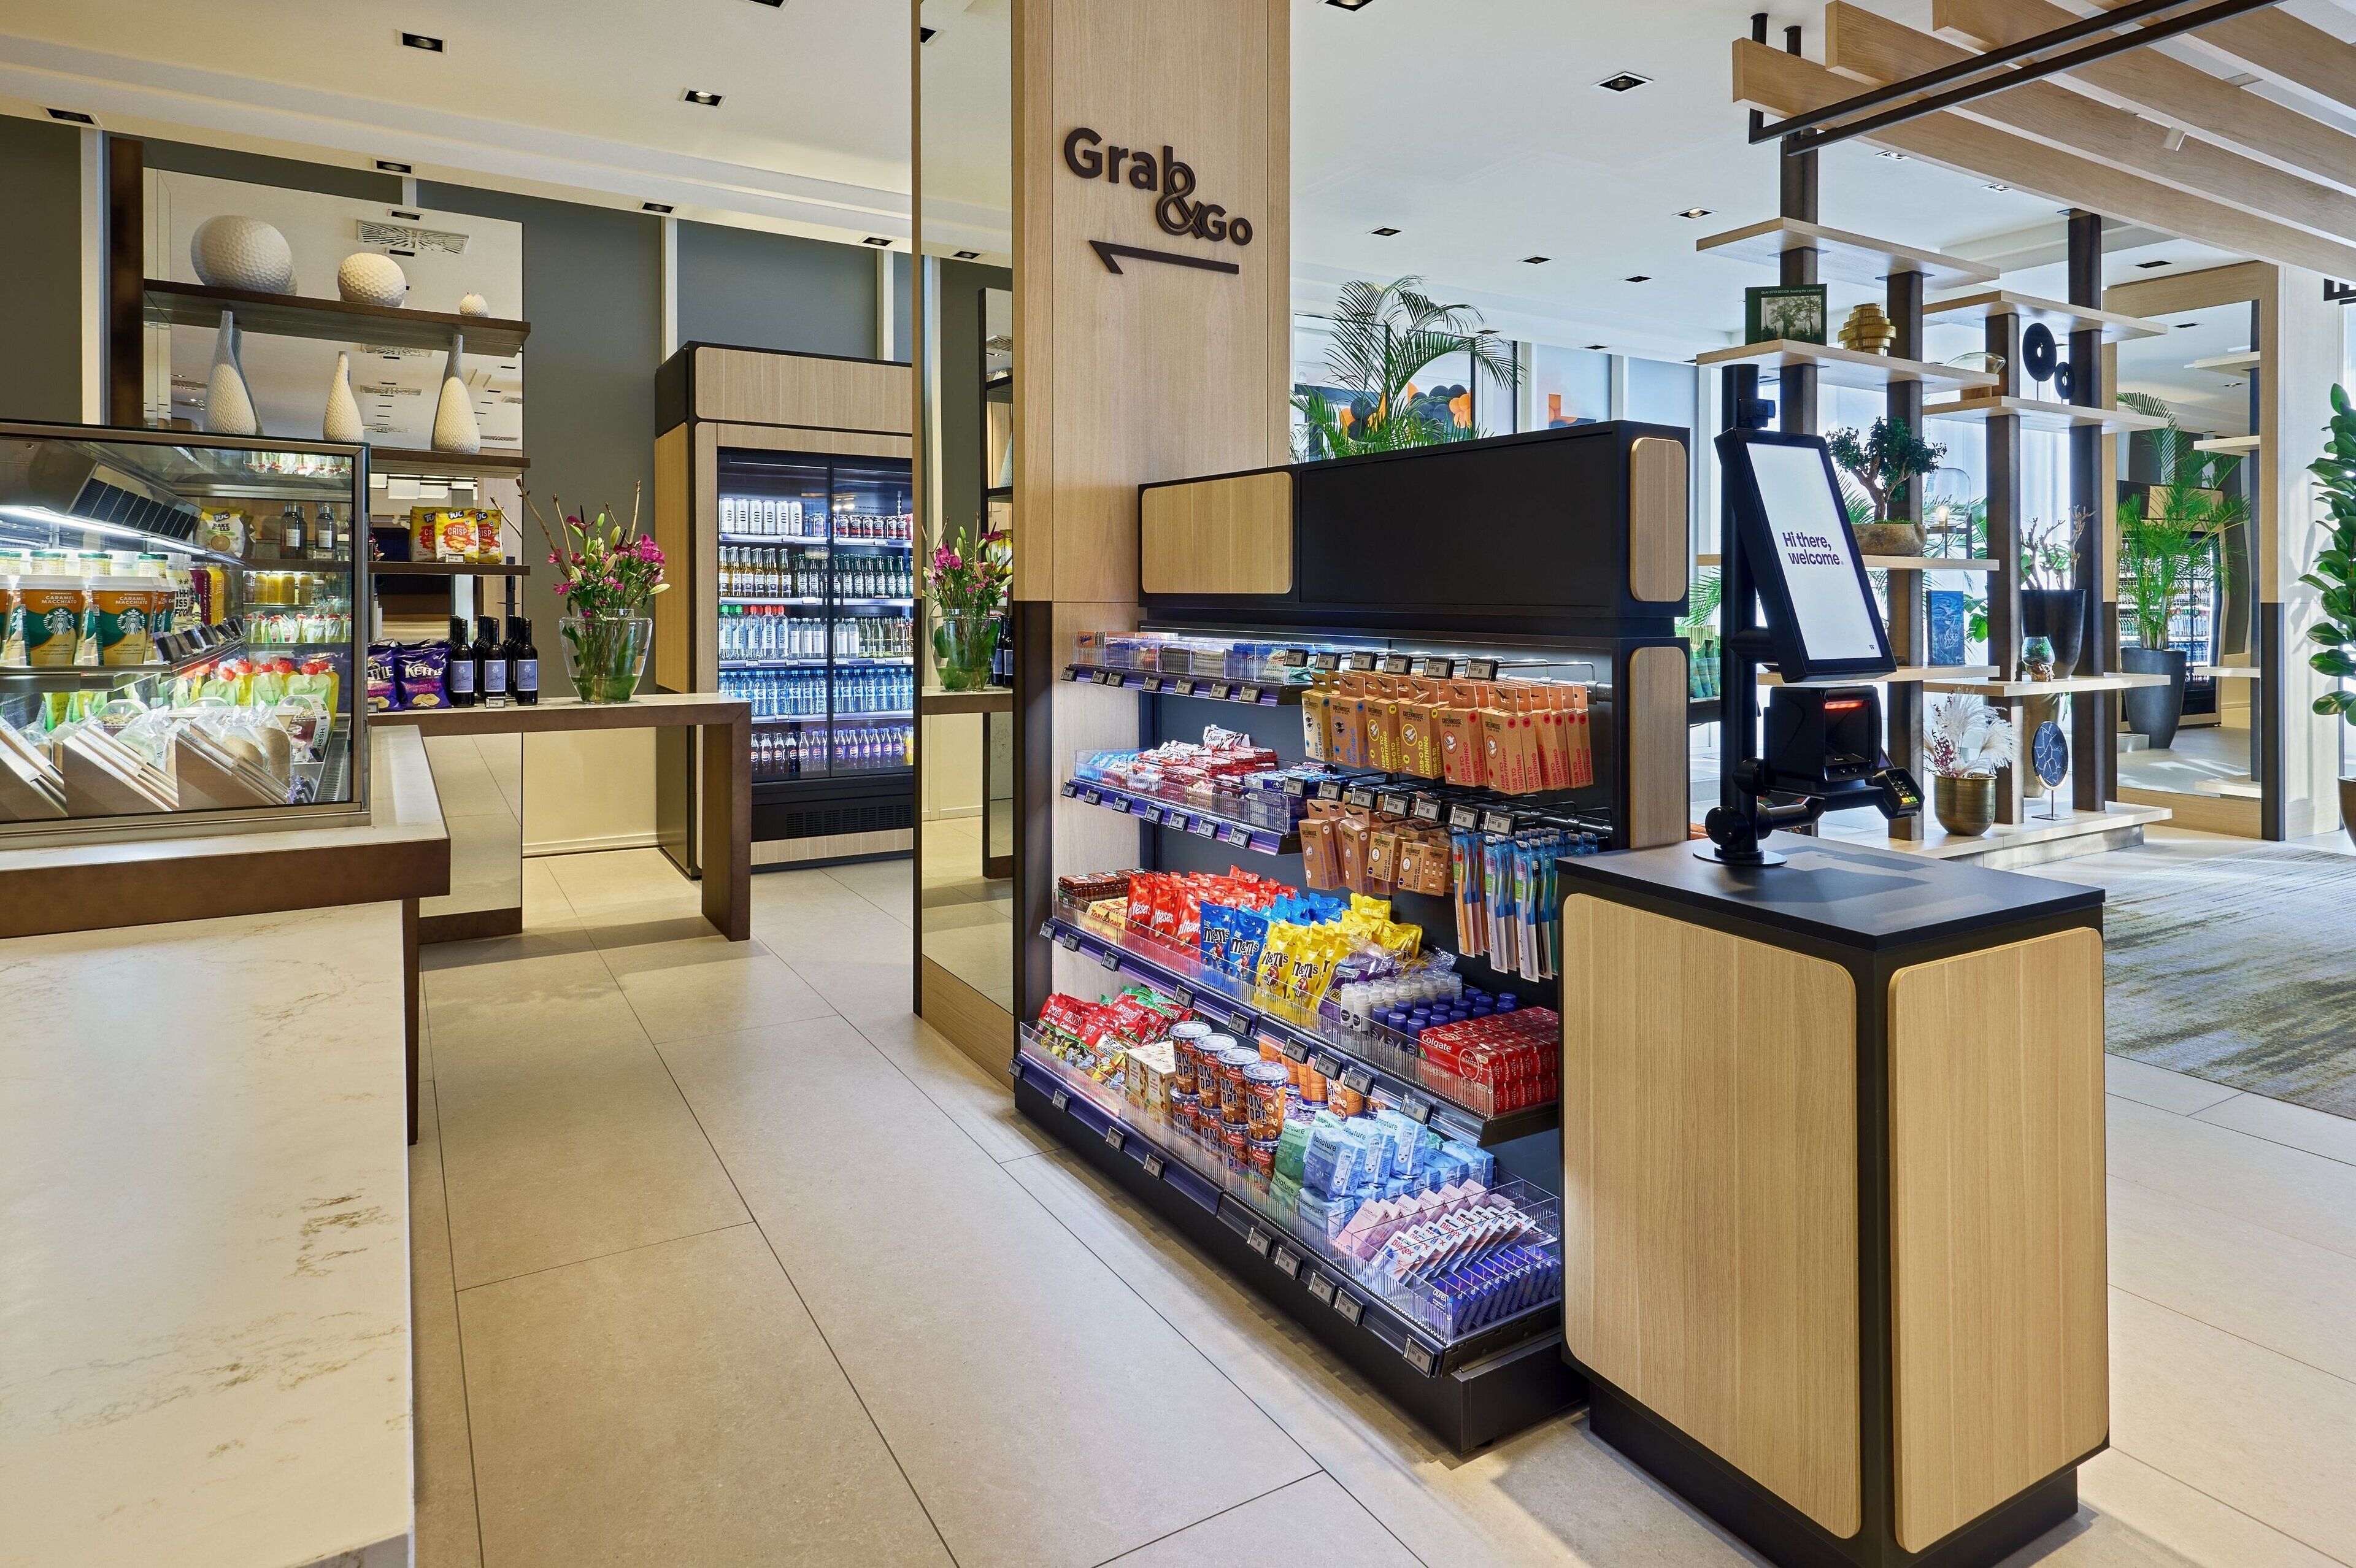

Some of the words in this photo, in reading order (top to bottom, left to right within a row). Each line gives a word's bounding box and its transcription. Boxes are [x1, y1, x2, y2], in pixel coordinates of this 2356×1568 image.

[1064, 127, 1196, 194] Grab
[447, 527, 468, 536] CRISP
[1782, 532, 1795, 548] Hi
[1795, 532, 1831, 551] there,
[1403, 711, 1423, 720] GREENHOUSE
[1380, 736, 1384, 745] TO
[1419, 741, 1423, 750] TO
[1460, 756, 1465, 766] TO
[1463, 742, 1472, 782] LIGHTNING
[1499, 762, 1504, 772] TO
[1553, 749, 1563, 783] LIGHTNING
[1512, 768, 1516, 777] TO
[1527, 767, 1532, 775] TO
[1331, 991, 1341, 1002] BI
[1422, 1034, 1452, 1053] Colgate
[1177, 1064, 1193, 1078] OP!
[1198, 1063, 1212, 1078] ON
[1199, 1077, 1215, 1092] OP!
[1220, 1077, 1233, 1093] ON
[1222, 1090, 1238, 1107] OP!
[1248, 1093, 1262, 1110] ON
[1249, 1107, 1266, 1124] OP!
[1284, 1123, 1305, 1134] sanature
[1314, 1136, 1337, 1151] sanature
[1362, 1207, 1377, 1218] sanature
[1391, 1239, 1414, 1256] Blistex
